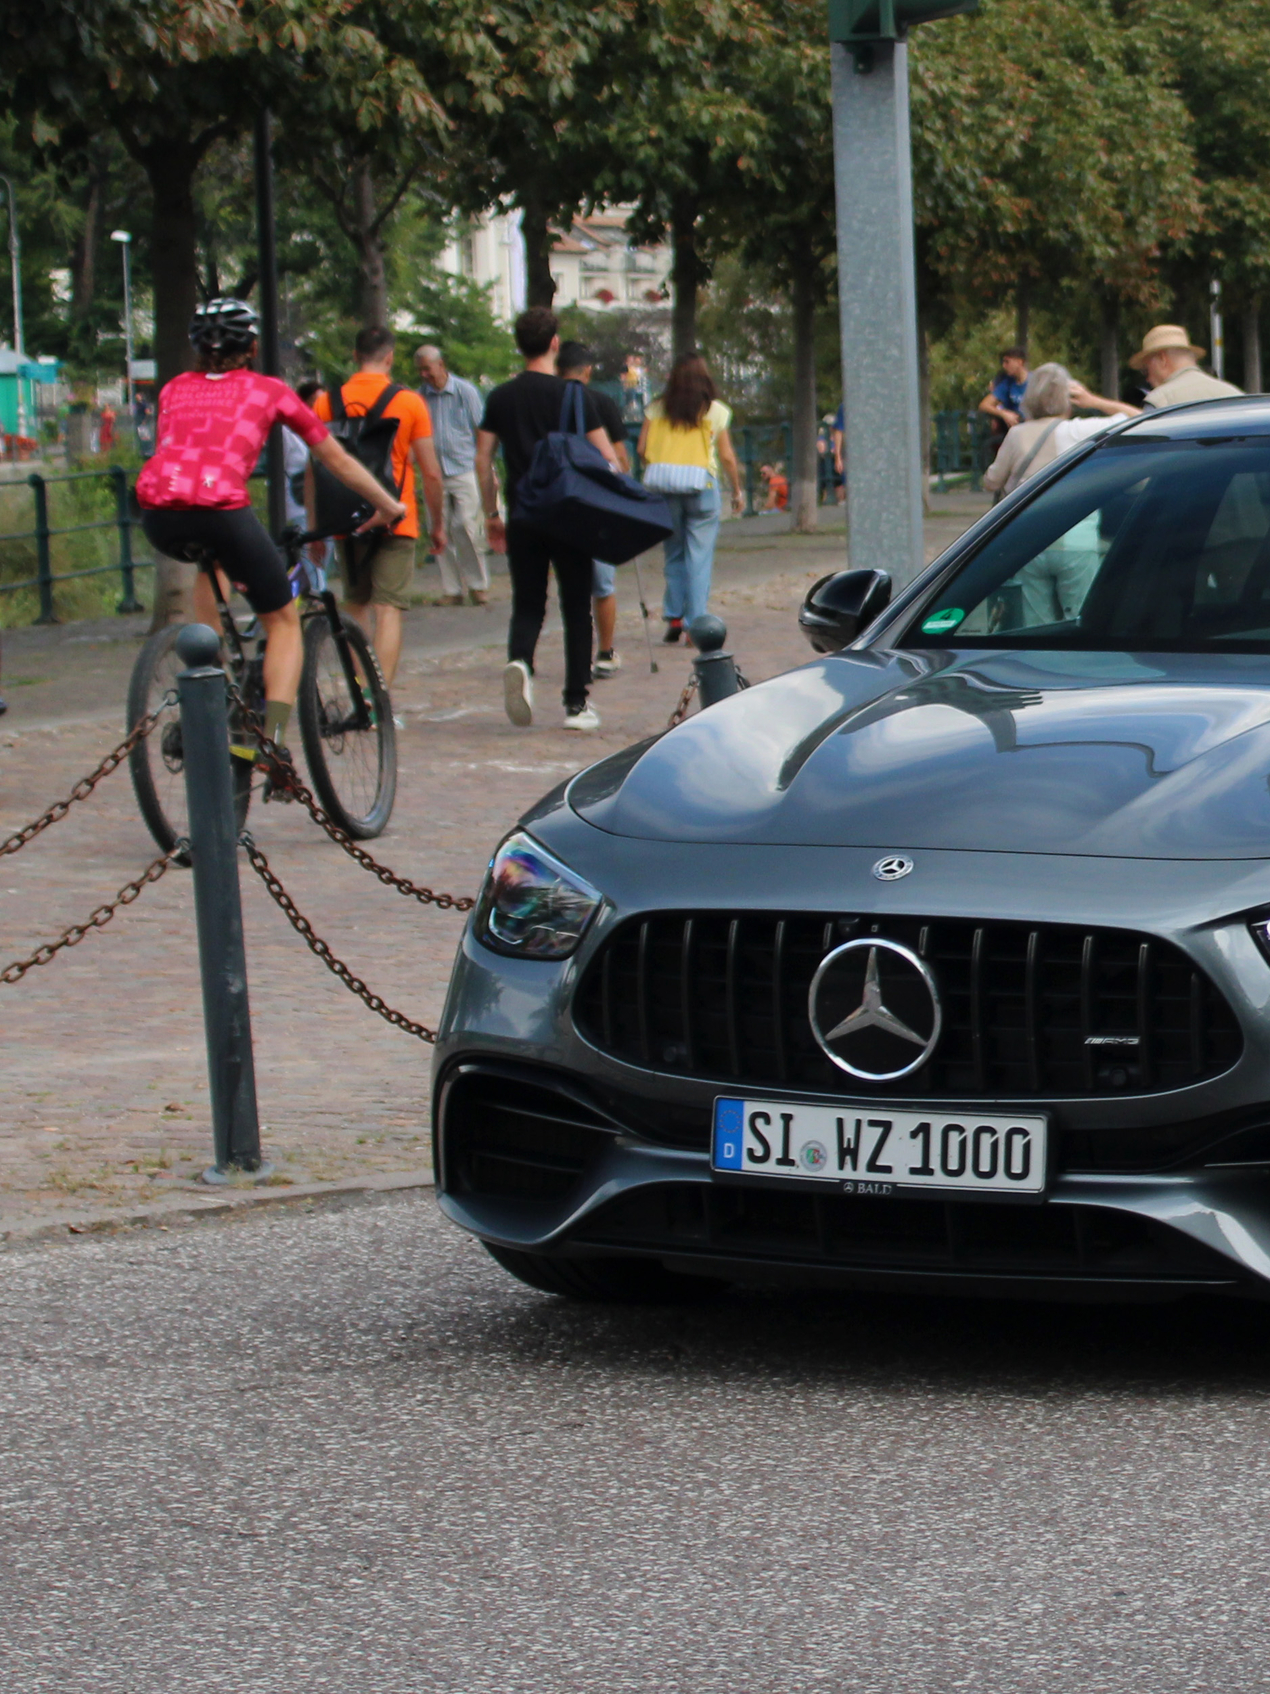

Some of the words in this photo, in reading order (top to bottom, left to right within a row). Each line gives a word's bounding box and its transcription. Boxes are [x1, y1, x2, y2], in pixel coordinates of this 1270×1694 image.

[723, 1143, 735, 1158] D
[746, 1111, 796, 1167] SI
[836, 1117, 893, 1174] WZ
[909, 1122, 1031, 1181] 1000
[857, 1182, 892, 1195] BALD
